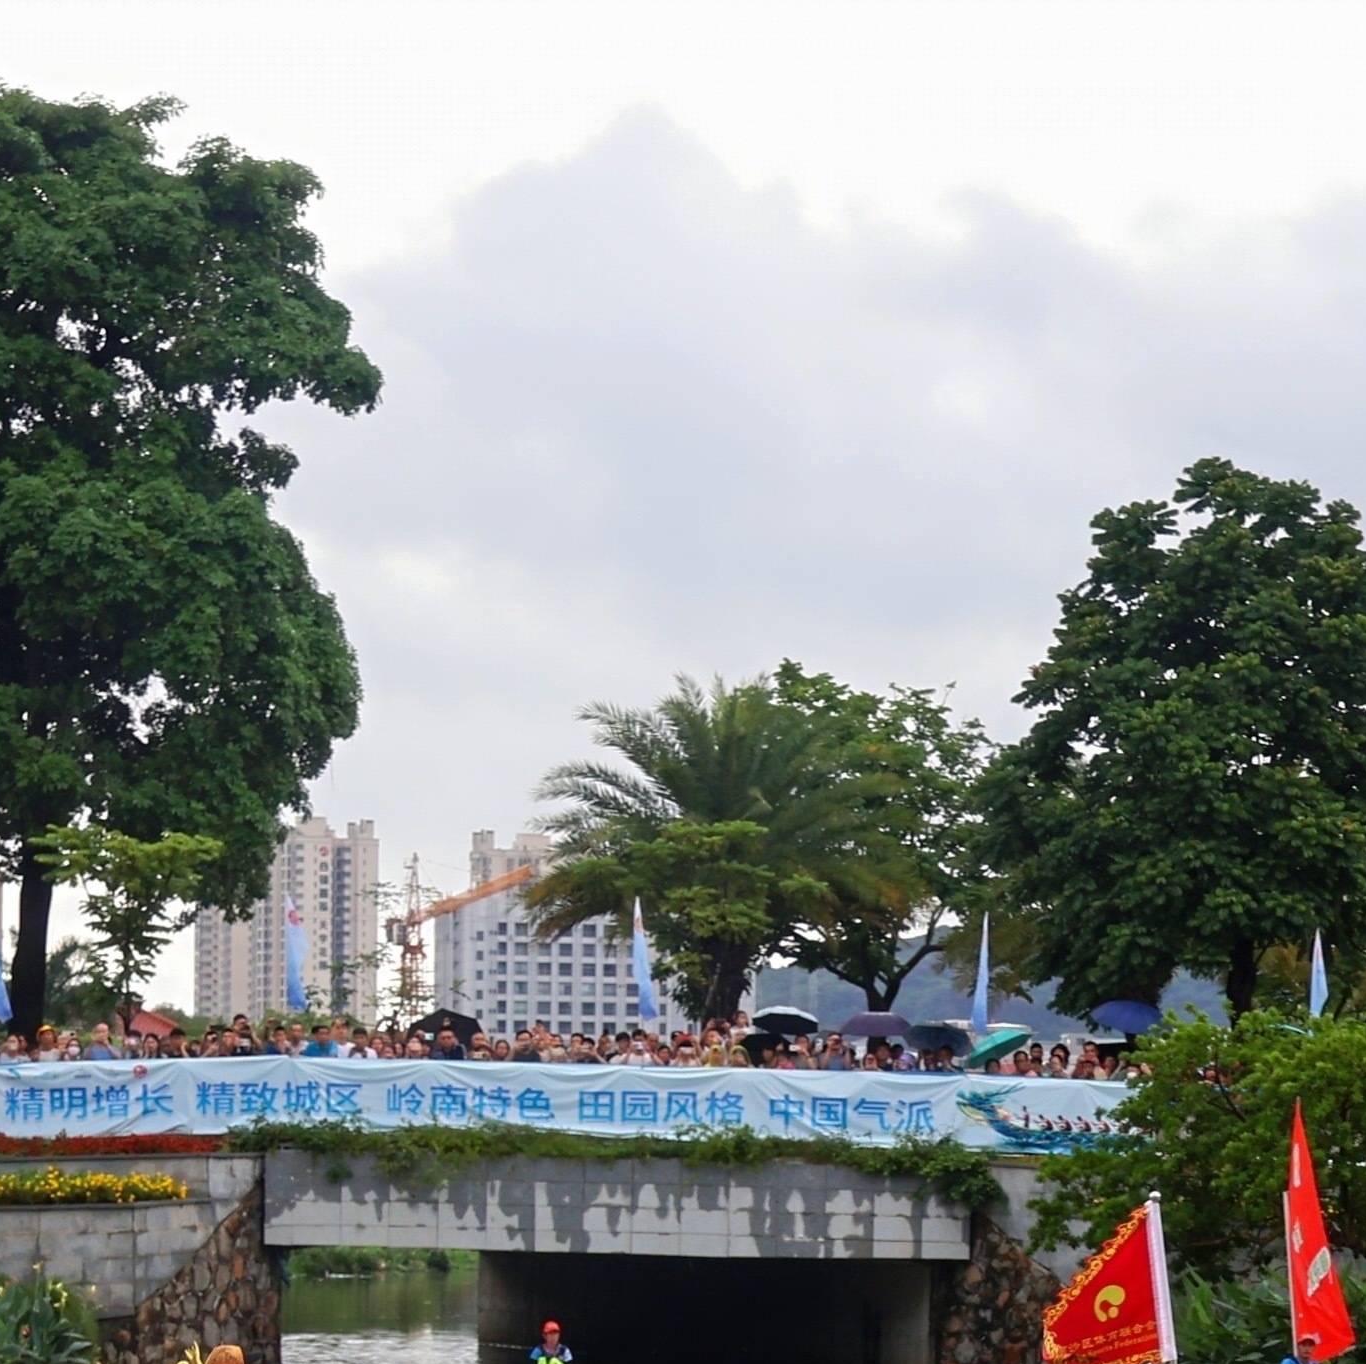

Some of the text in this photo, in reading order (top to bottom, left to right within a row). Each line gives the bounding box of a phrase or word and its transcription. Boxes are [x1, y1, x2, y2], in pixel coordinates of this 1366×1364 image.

[5, 1081, 936, 1133] 精明增长 精致城区 岭南特色 田园风格 中国气派
